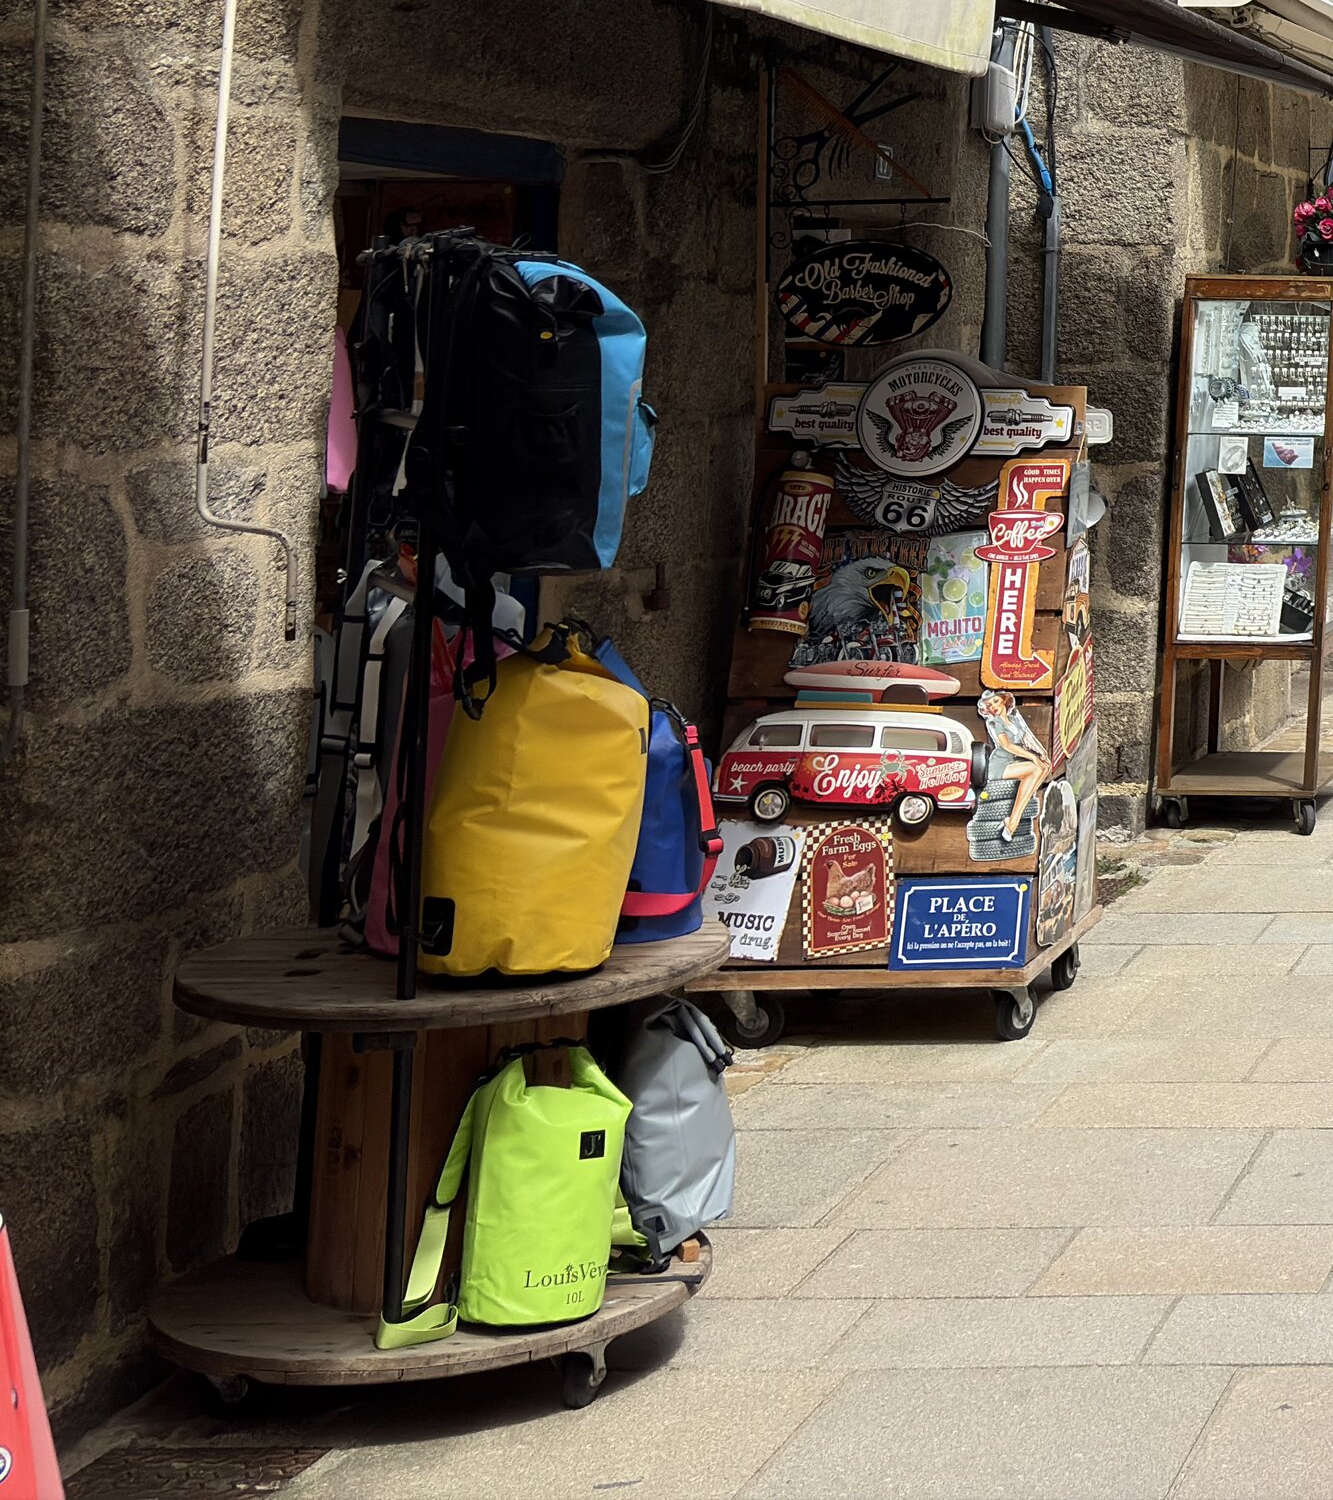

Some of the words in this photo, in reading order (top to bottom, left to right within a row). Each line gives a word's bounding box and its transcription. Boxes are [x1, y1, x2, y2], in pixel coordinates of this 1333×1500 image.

[795, 257, 841, 289] Old
[843, 253, 937, 288] Fashioned
[822, 278, 874, 304] Barber
[873, 284, 915, 310] Shop
[888, 371, 963, 397] MOTORCYCLES
[794, 418, 816, 429] best
[818, 419, 854, 432] quality
[983, 426, 1005, 436] best
[1006, 426, 1042, 439] quality
[893, 483, 932, 497] HISTORIC
[888, 493, 932, 506] ROUTE
[770, 493, 832, 540] ARAGE
[882, 501, 929, 528] 66
[992, 521, 1048, 548] Coffee
[997, 568, 1022, 655] HERE
[927, 616, 982, 638] MOJITO
[847, 661, 902, 681] Surfer
[1000, 661, 1022, 669] Always
[1013, 671, 1037, 679] Natural
[731, 761, 763, 773] beach
[764, 762, 795, 779] party
[812, 754, 882, 800] Enjoy
[916, 761, 967, 779] Summer
[833, 832, 861, 845] Fresh
[822, 845, 849, 856] Farm
[853, 840, 877, 853] Eggs
[928, 896, 995, 913] PLACE
[718, 911, 775, 932] MUSIC
[953, 913, 967, 922] DE
[924, 920, 996, 938] L'APÉRO
[740, 933, 774, 951] drug.
[919, 941, 940, 952] pression
[566, 1290, 585, 1305] 10L
